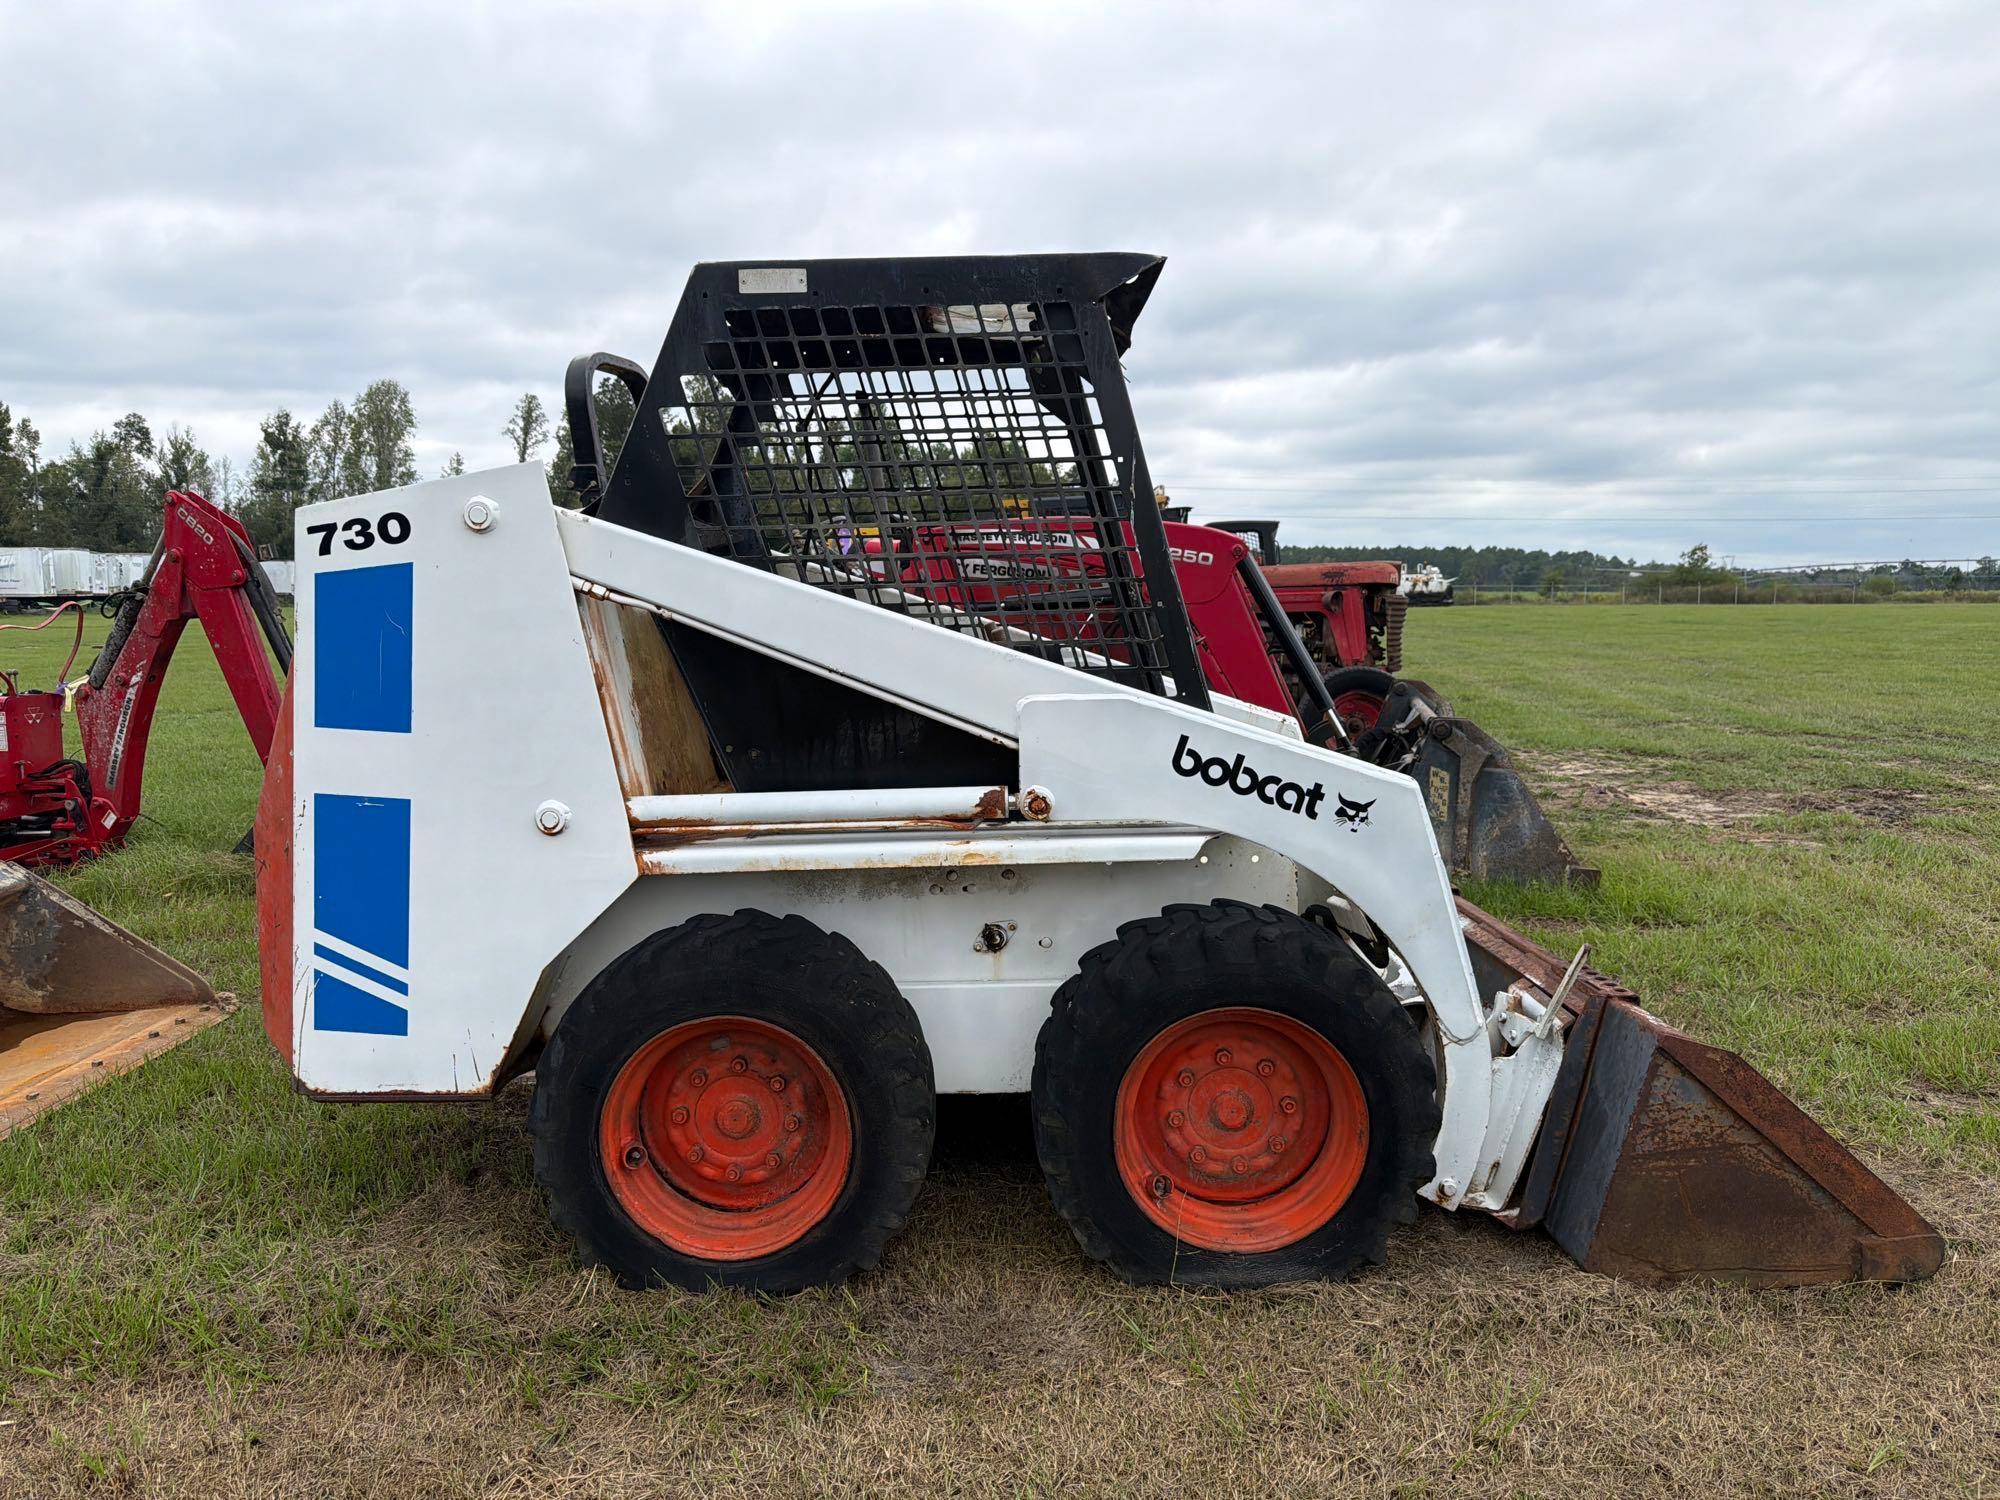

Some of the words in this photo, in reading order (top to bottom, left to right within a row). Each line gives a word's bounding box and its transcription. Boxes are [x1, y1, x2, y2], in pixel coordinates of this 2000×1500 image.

[177, 507, 214, 545] CB20
[307, 512, 412, 557] 730
[1172, 735, 1325, 821] bobcat
